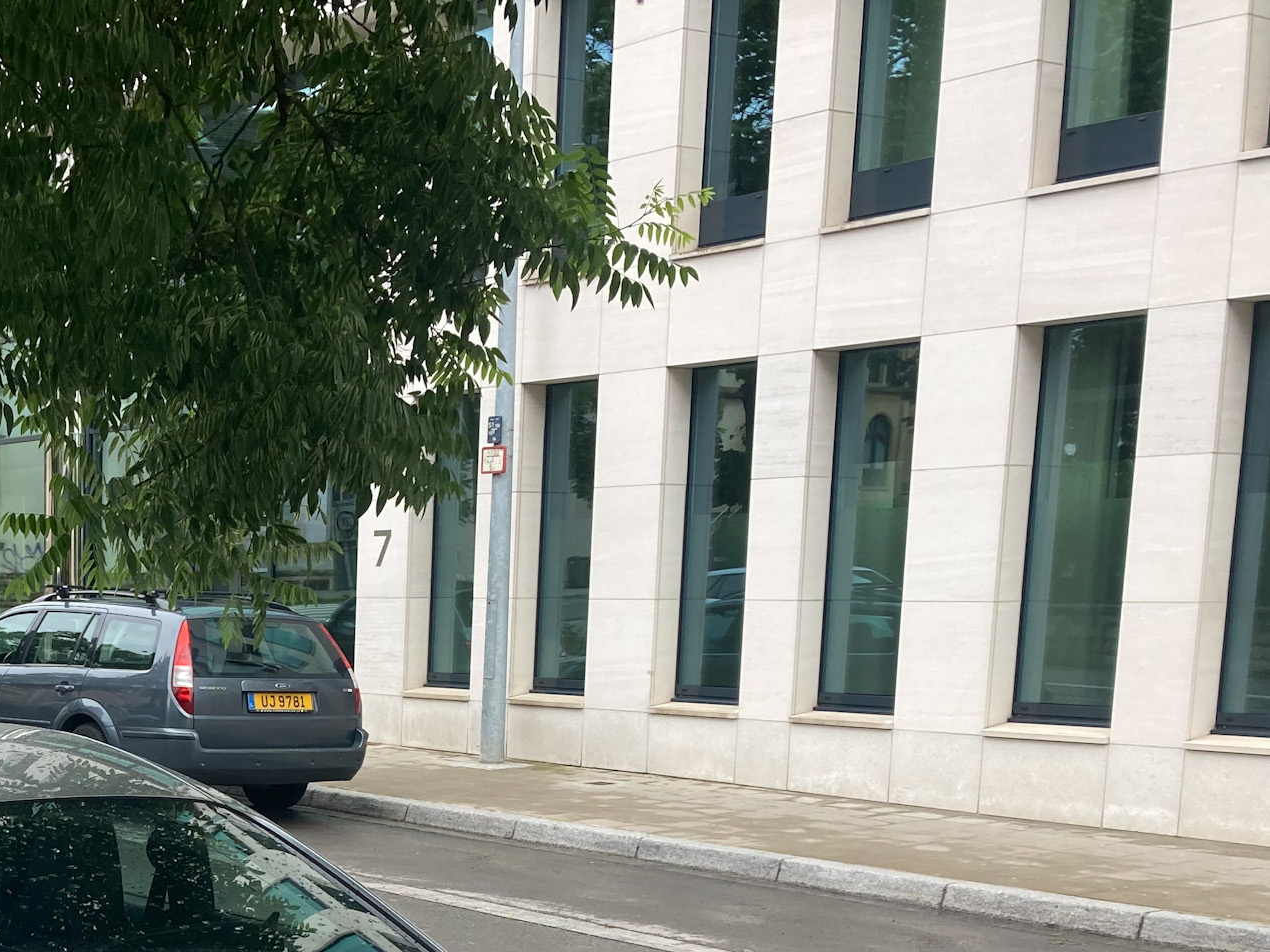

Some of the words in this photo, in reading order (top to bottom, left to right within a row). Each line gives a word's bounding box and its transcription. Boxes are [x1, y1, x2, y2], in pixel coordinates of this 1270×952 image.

[373, 529, 392, 567] 7
[261, 695, 276, 708] UJ
[278, 695, 305, 708] 9781
